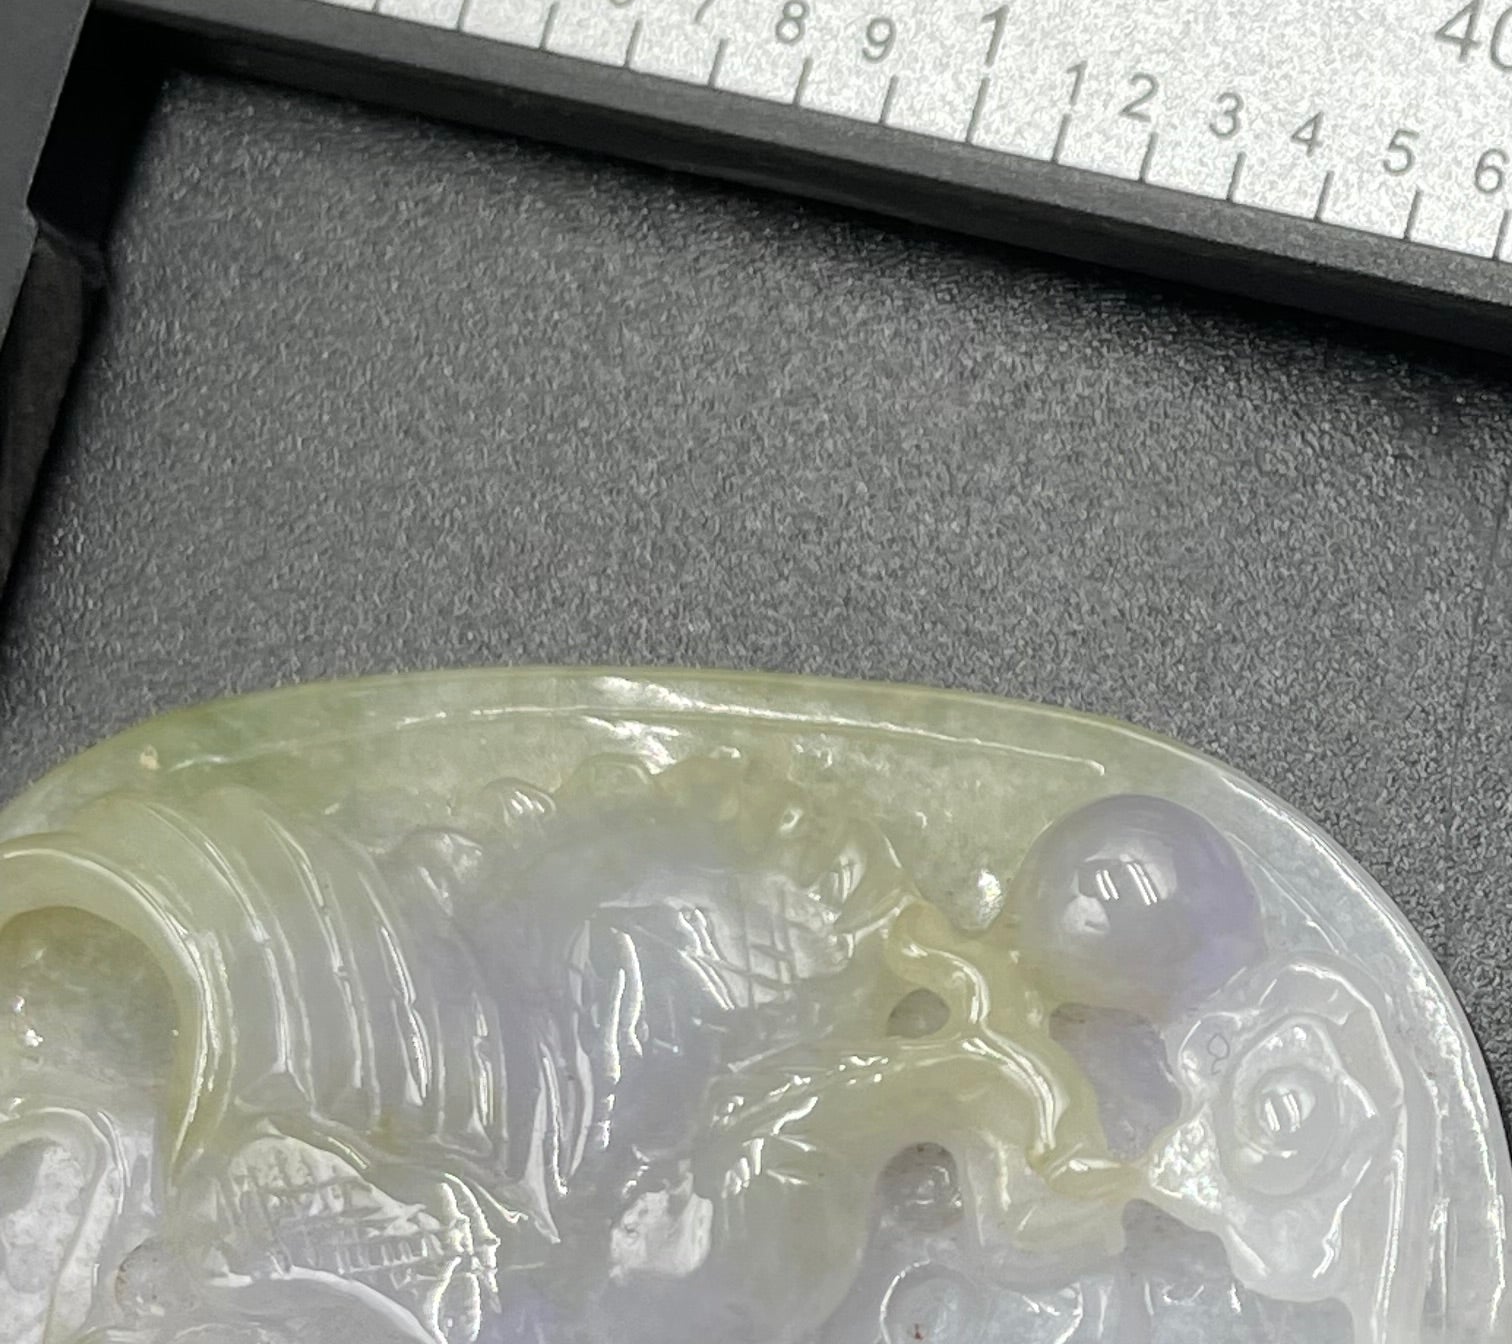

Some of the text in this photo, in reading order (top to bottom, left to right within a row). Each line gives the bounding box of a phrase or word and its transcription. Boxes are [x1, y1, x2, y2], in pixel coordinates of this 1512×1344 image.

[775, 0, 811, 45] 8
[861, 18, 897, 63] 9
[979, 5, 1010, 67] 1
[1066, 60, 1090, 106] 1
[1120, 73, 1161, 123] 2
[1209, 92, 1245, 140] 3
[1291, 112, 1327, 157] 4
[1383, 129, 1420, 178] 5
[1473, 149, 1509, 196] 6
